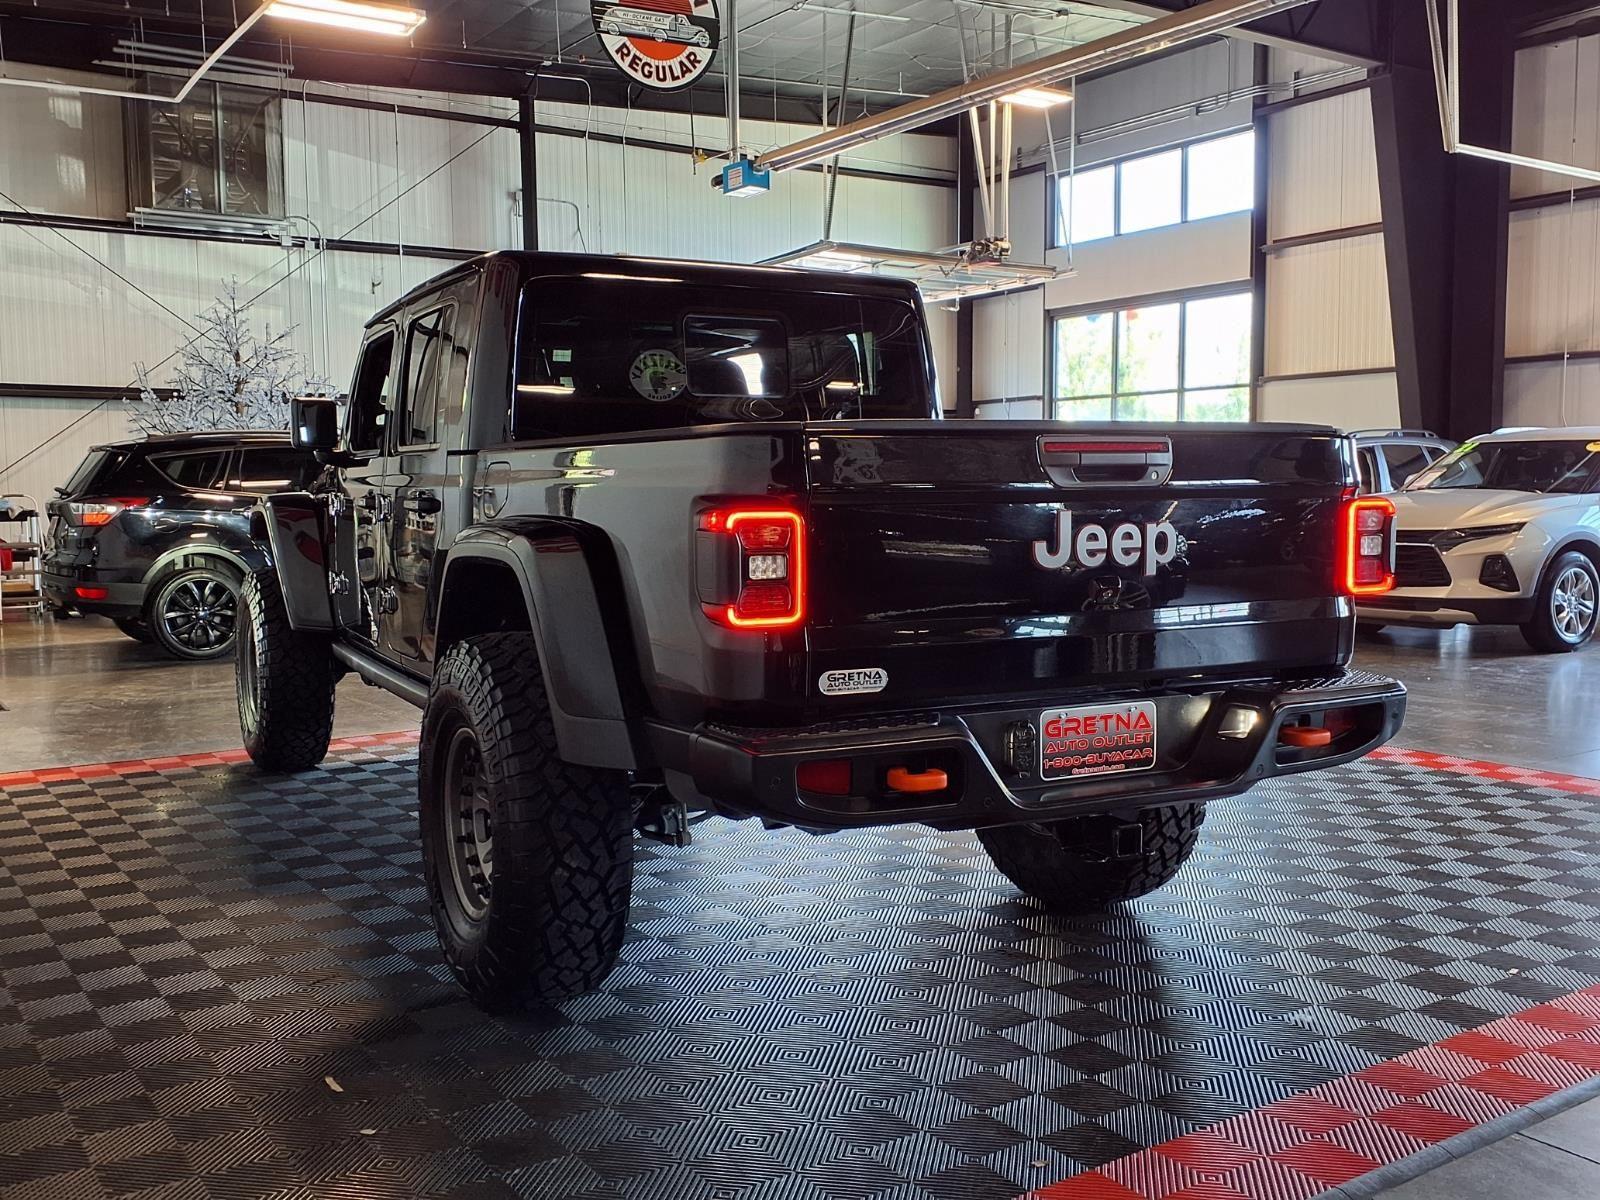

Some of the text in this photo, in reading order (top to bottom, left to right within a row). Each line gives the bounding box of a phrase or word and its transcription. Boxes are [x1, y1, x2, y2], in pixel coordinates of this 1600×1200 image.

[615, 42, 702, 82] REGULAR
[1033, 510, 1177, 576] Jeep
[827, 671, 883, 682] GRETNA
[1044, 711, 1152, 738] GRETNA
[1044, 732, 1153, 753] AUTO OUTLET
[1043, 748, 1153, 769] 1-800-BUYACAR
